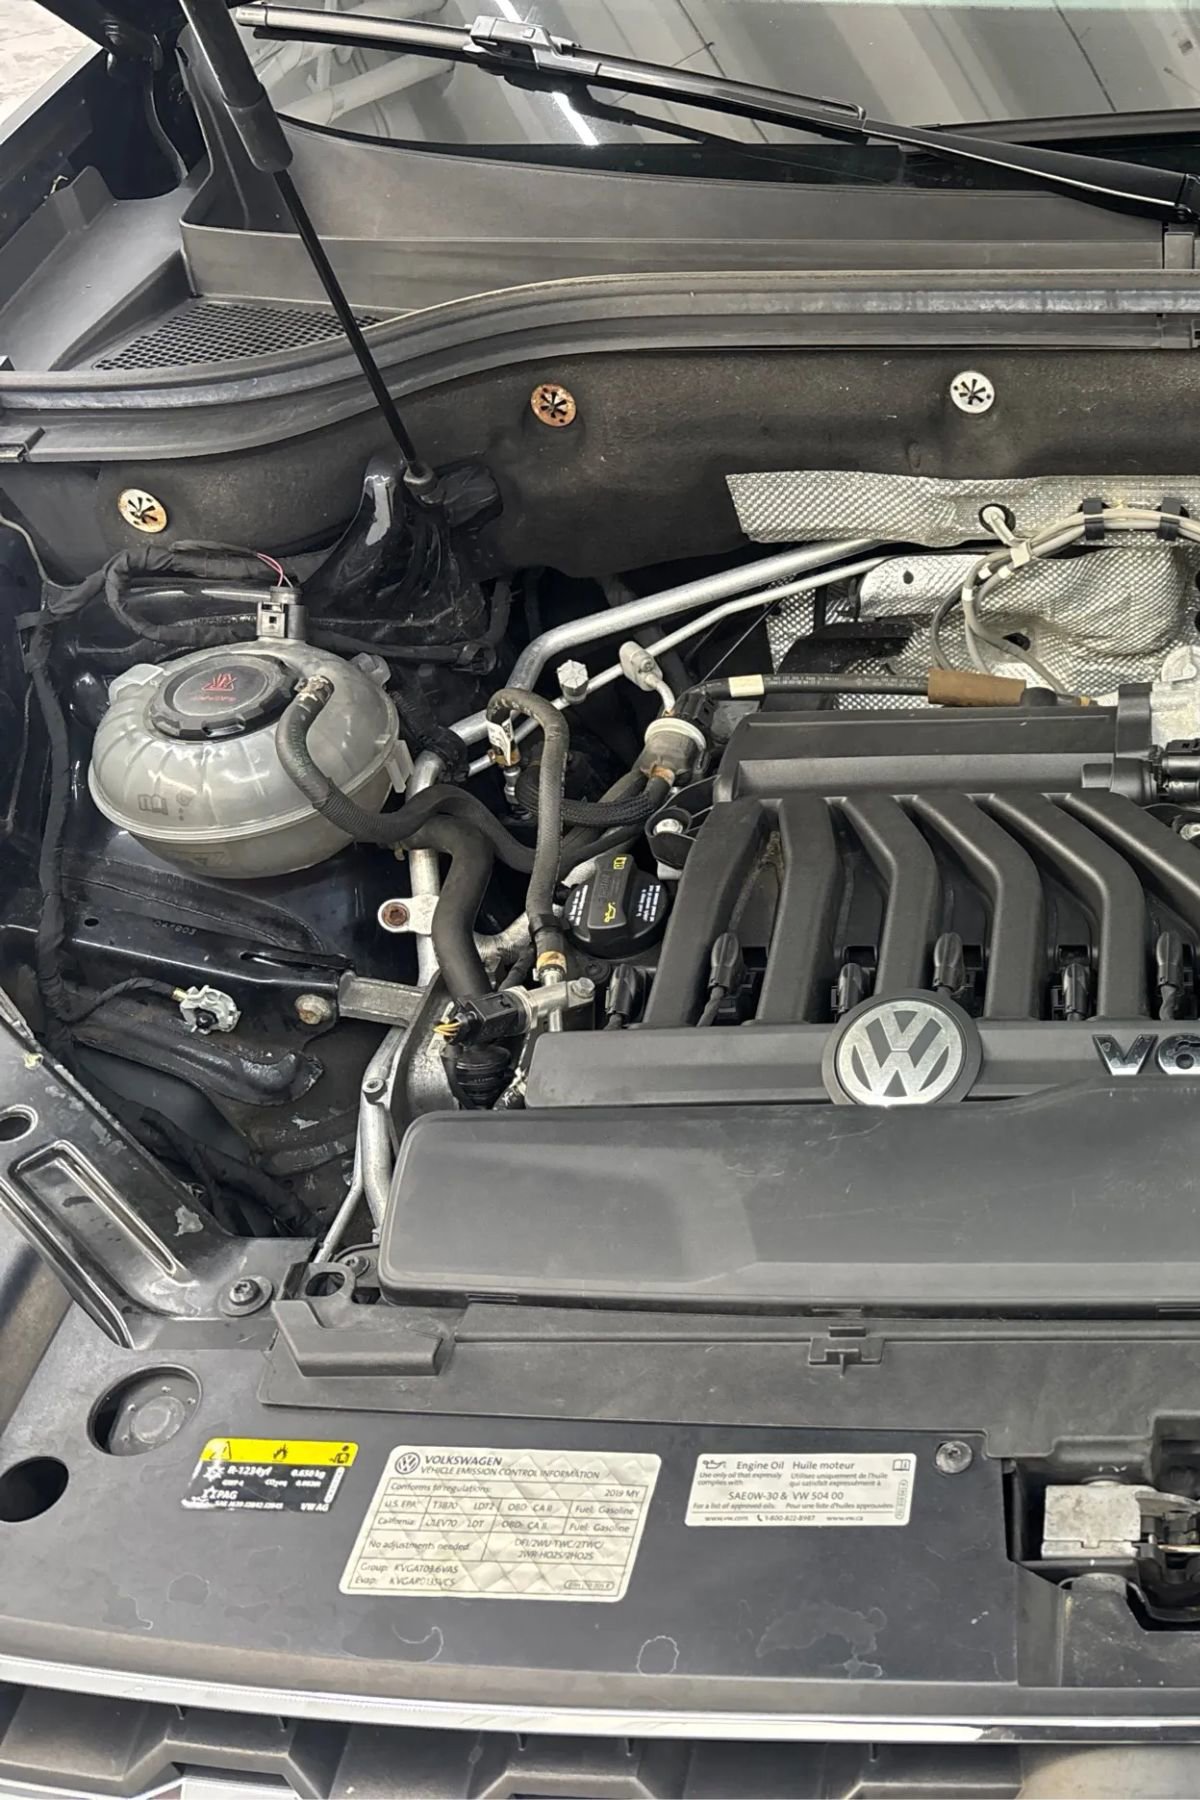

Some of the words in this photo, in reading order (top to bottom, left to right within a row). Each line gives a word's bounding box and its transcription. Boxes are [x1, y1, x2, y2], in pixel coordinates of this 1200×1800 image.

[425, 1455, 503, 1466] VOLKSWAGEN
[736, 1460, 769, 1472] Engine
[770, 1461, 785, 1470] Oil
[792, 1461, 817, 1470] Huile
[819, 1462, 856, 1470] moteur
[420, 1466, 454, 1475] VEHICLE
[456, 1467, 497, 1476] EMISSION
[498, 1468, 538, 1477] CONTROL
[540, 1469, 601, 1479] INFORMATION
[713, 1472, 727, 1480] only
[390, 1482, 430, 1492] Conforms
[217, 1490, 239, 1500] PAG
[604, 1489, 625, 1498] 2019
[626, 1489, 641, 1498] MY
[780, 1491, 788, 1501] &
[792, 1491, 810, 1500] VW
[811, 1491, 829, 1500] 504
[830, 1491, 844, 1500] 00
[300, 1502, 316, 1512] VW
[316, 1503, 330, 1512] AG
[533, 1503, 545, 1512] CA
[598, 1505, 635, 1515] Gasoline
[692, 1502, 705, 1510] For
[730, 1502, 762, 1511] approved
[816, 1501, 829, 1509] liste
[527, 1520, 540, 1530] CA
[369, 1540, 381, 1549] No
[382, 1540, 436, 1552] adjustments
